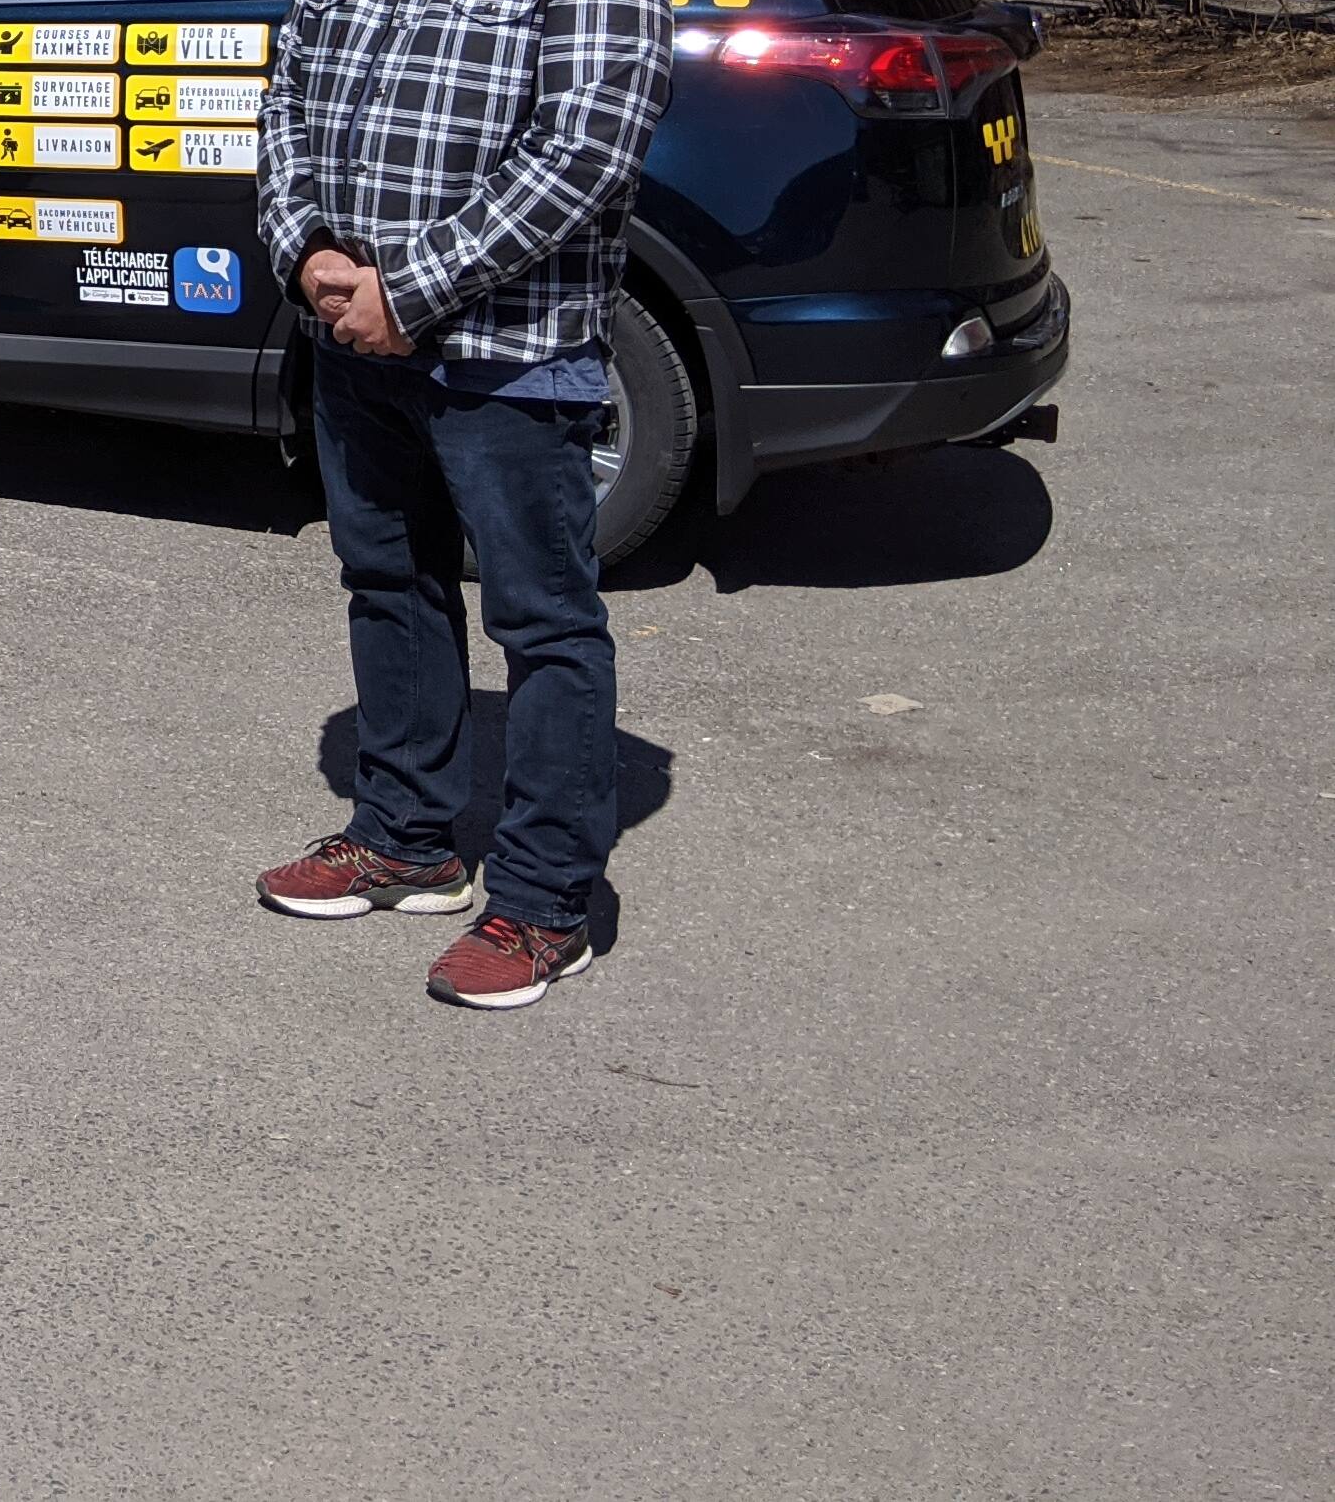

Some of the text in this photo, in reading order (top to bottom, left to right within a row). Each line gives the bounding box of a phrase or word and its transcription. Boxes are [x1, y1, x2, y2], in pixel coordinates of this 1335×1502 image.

[35, 29, 111, 40] COURSES AU
[181, 28, 236, 39] TOUR DE
[34, 40, 109, 56] TAXIMÈTRE
[181, 40, 243, 59] VILLE
[34, 81, 111, 94] SURVOLTAGE
[179, 86, 259, 98] DÉVERROUILLAGE
[33, 95, 111, 108] DE BATTERIE
[179, 96, 260, 111] DE PORTIÈRE
[37, 138, 112, 153] LIVRAISON
[185, 134, 252, 147] PRIX FIXE
[185, 146, 222, 166] YQB
[39, 218, 116, 234] DE VÉHICULE
[82, 247, 169, 270] TÉLÉCHARGEZ
[76, 267, 169, 289] L'APPLICATION!
[180, 281, 233, 301] TAXI
